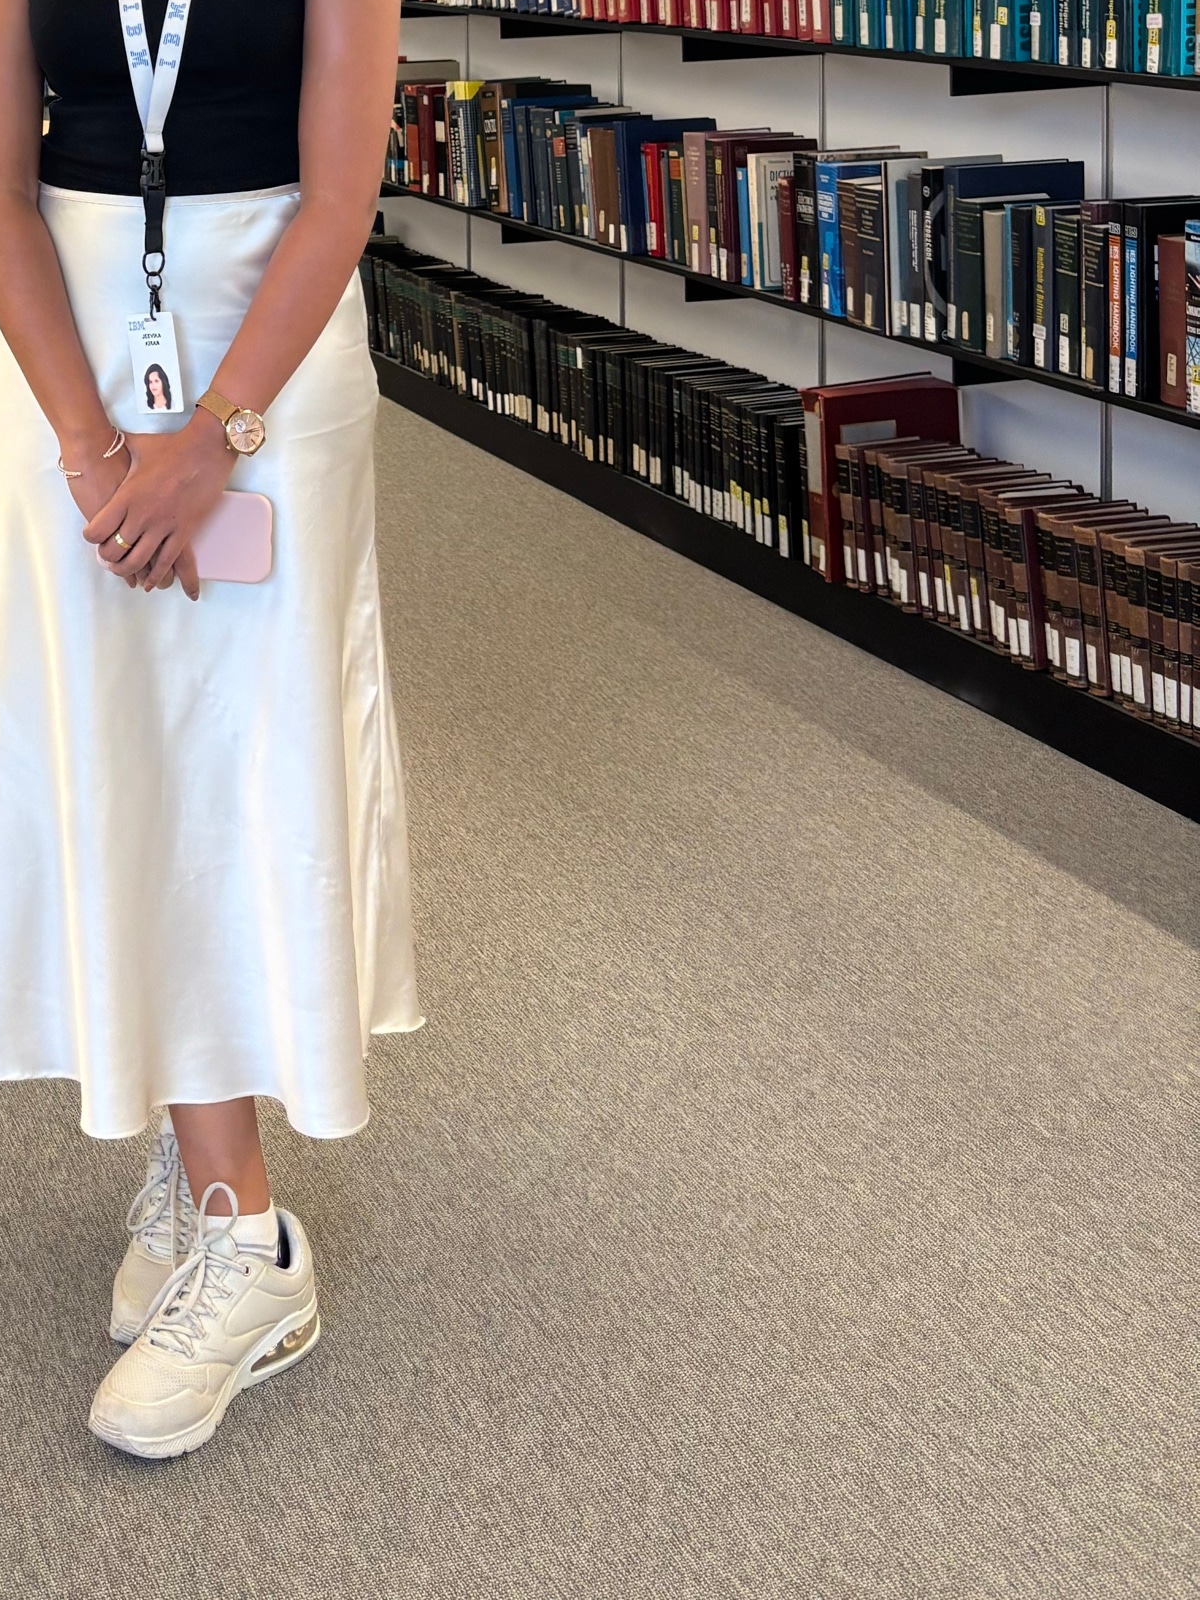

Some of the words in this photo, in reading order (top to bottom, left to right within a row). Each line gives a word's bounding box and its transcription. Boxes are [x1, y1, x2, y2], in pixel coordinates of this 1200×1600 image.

[123, 3, 149, 69] IBM
[159, 2, 187, 69] IBM
[1037, 247, 1045, 283] Handbook
[128, 321, 146, 332] IBM
[1112, 302, 1120, 350] HANDBOOK
